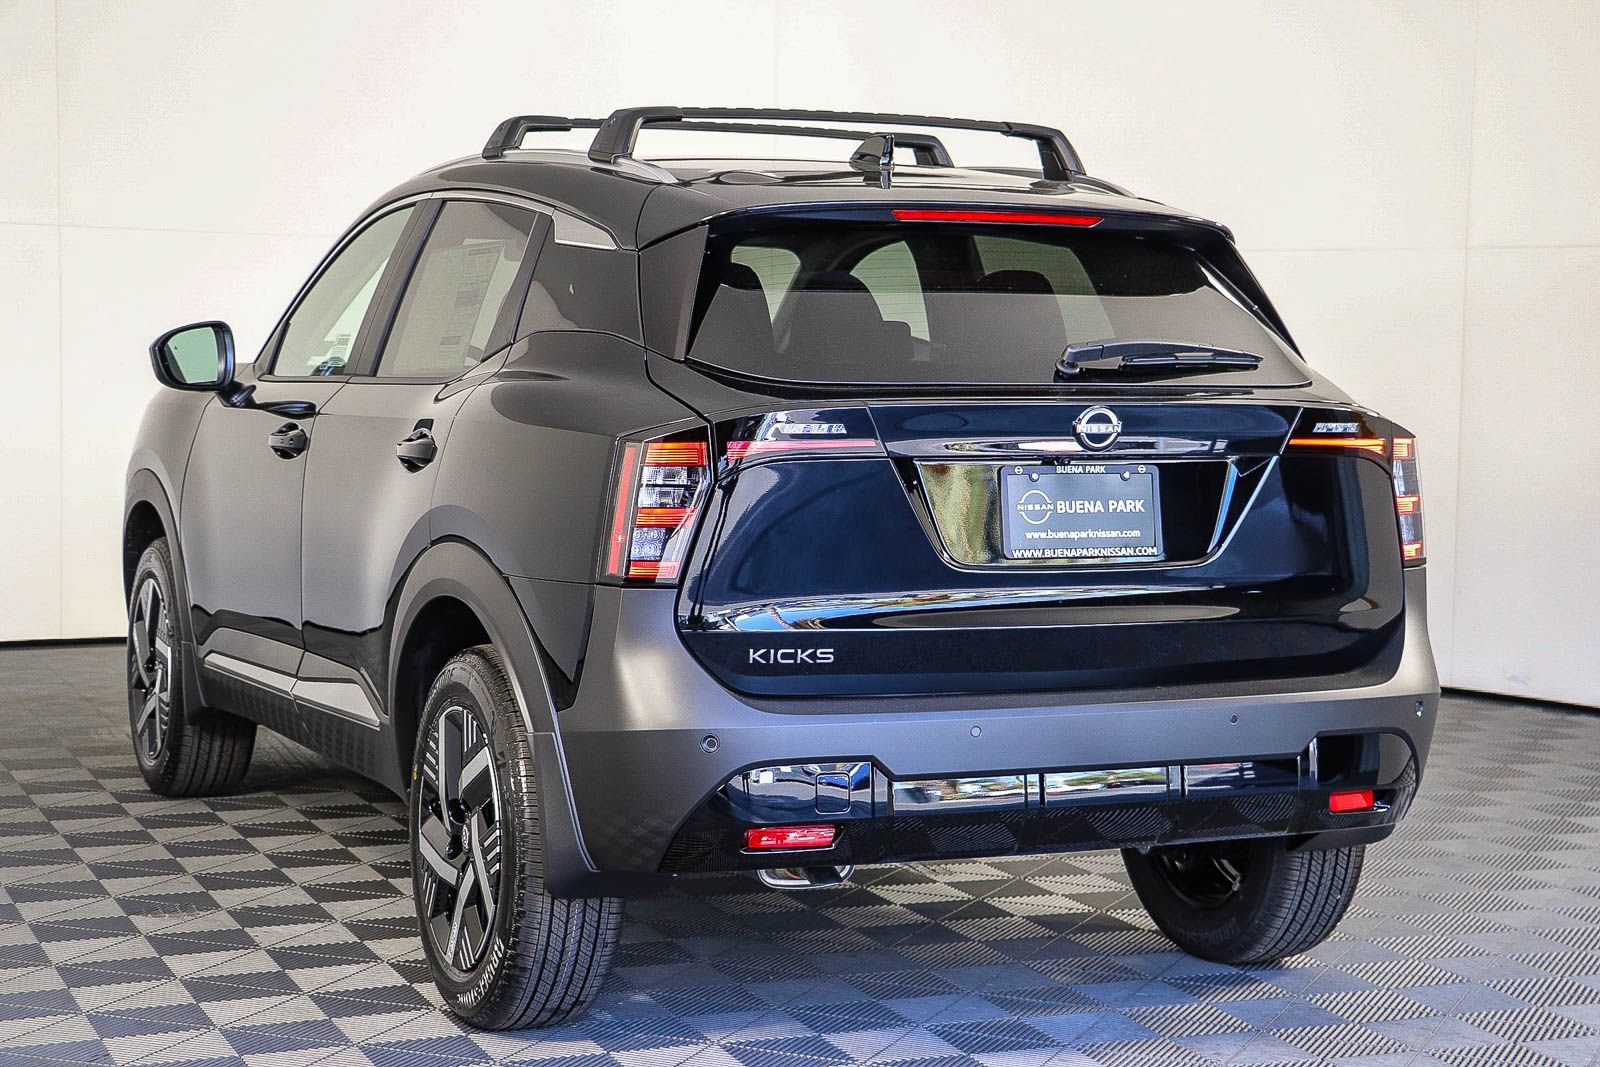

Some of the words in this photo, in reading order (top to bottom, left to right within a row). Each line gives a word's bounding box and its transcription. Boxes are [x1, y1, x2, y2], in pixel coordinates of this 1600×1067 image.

[1076, 424, 1121, 434] NISSAN
[1056, 465, 1083, 474] BUENA
[1086, 465, 1106, 474] PARK
[1017, 503, 1054, 511] NISSAN
[1056, 500, 1104, 513] BUENA
[1109, 500, 1145, 513] PARK
[1025, 529, 1141, 541] www.buenaparknissan.com
[1012, 546, 1158, 559] WWW.BUENAPARKNISSAN.COM
[748, 648, 834, 664] KICKS
